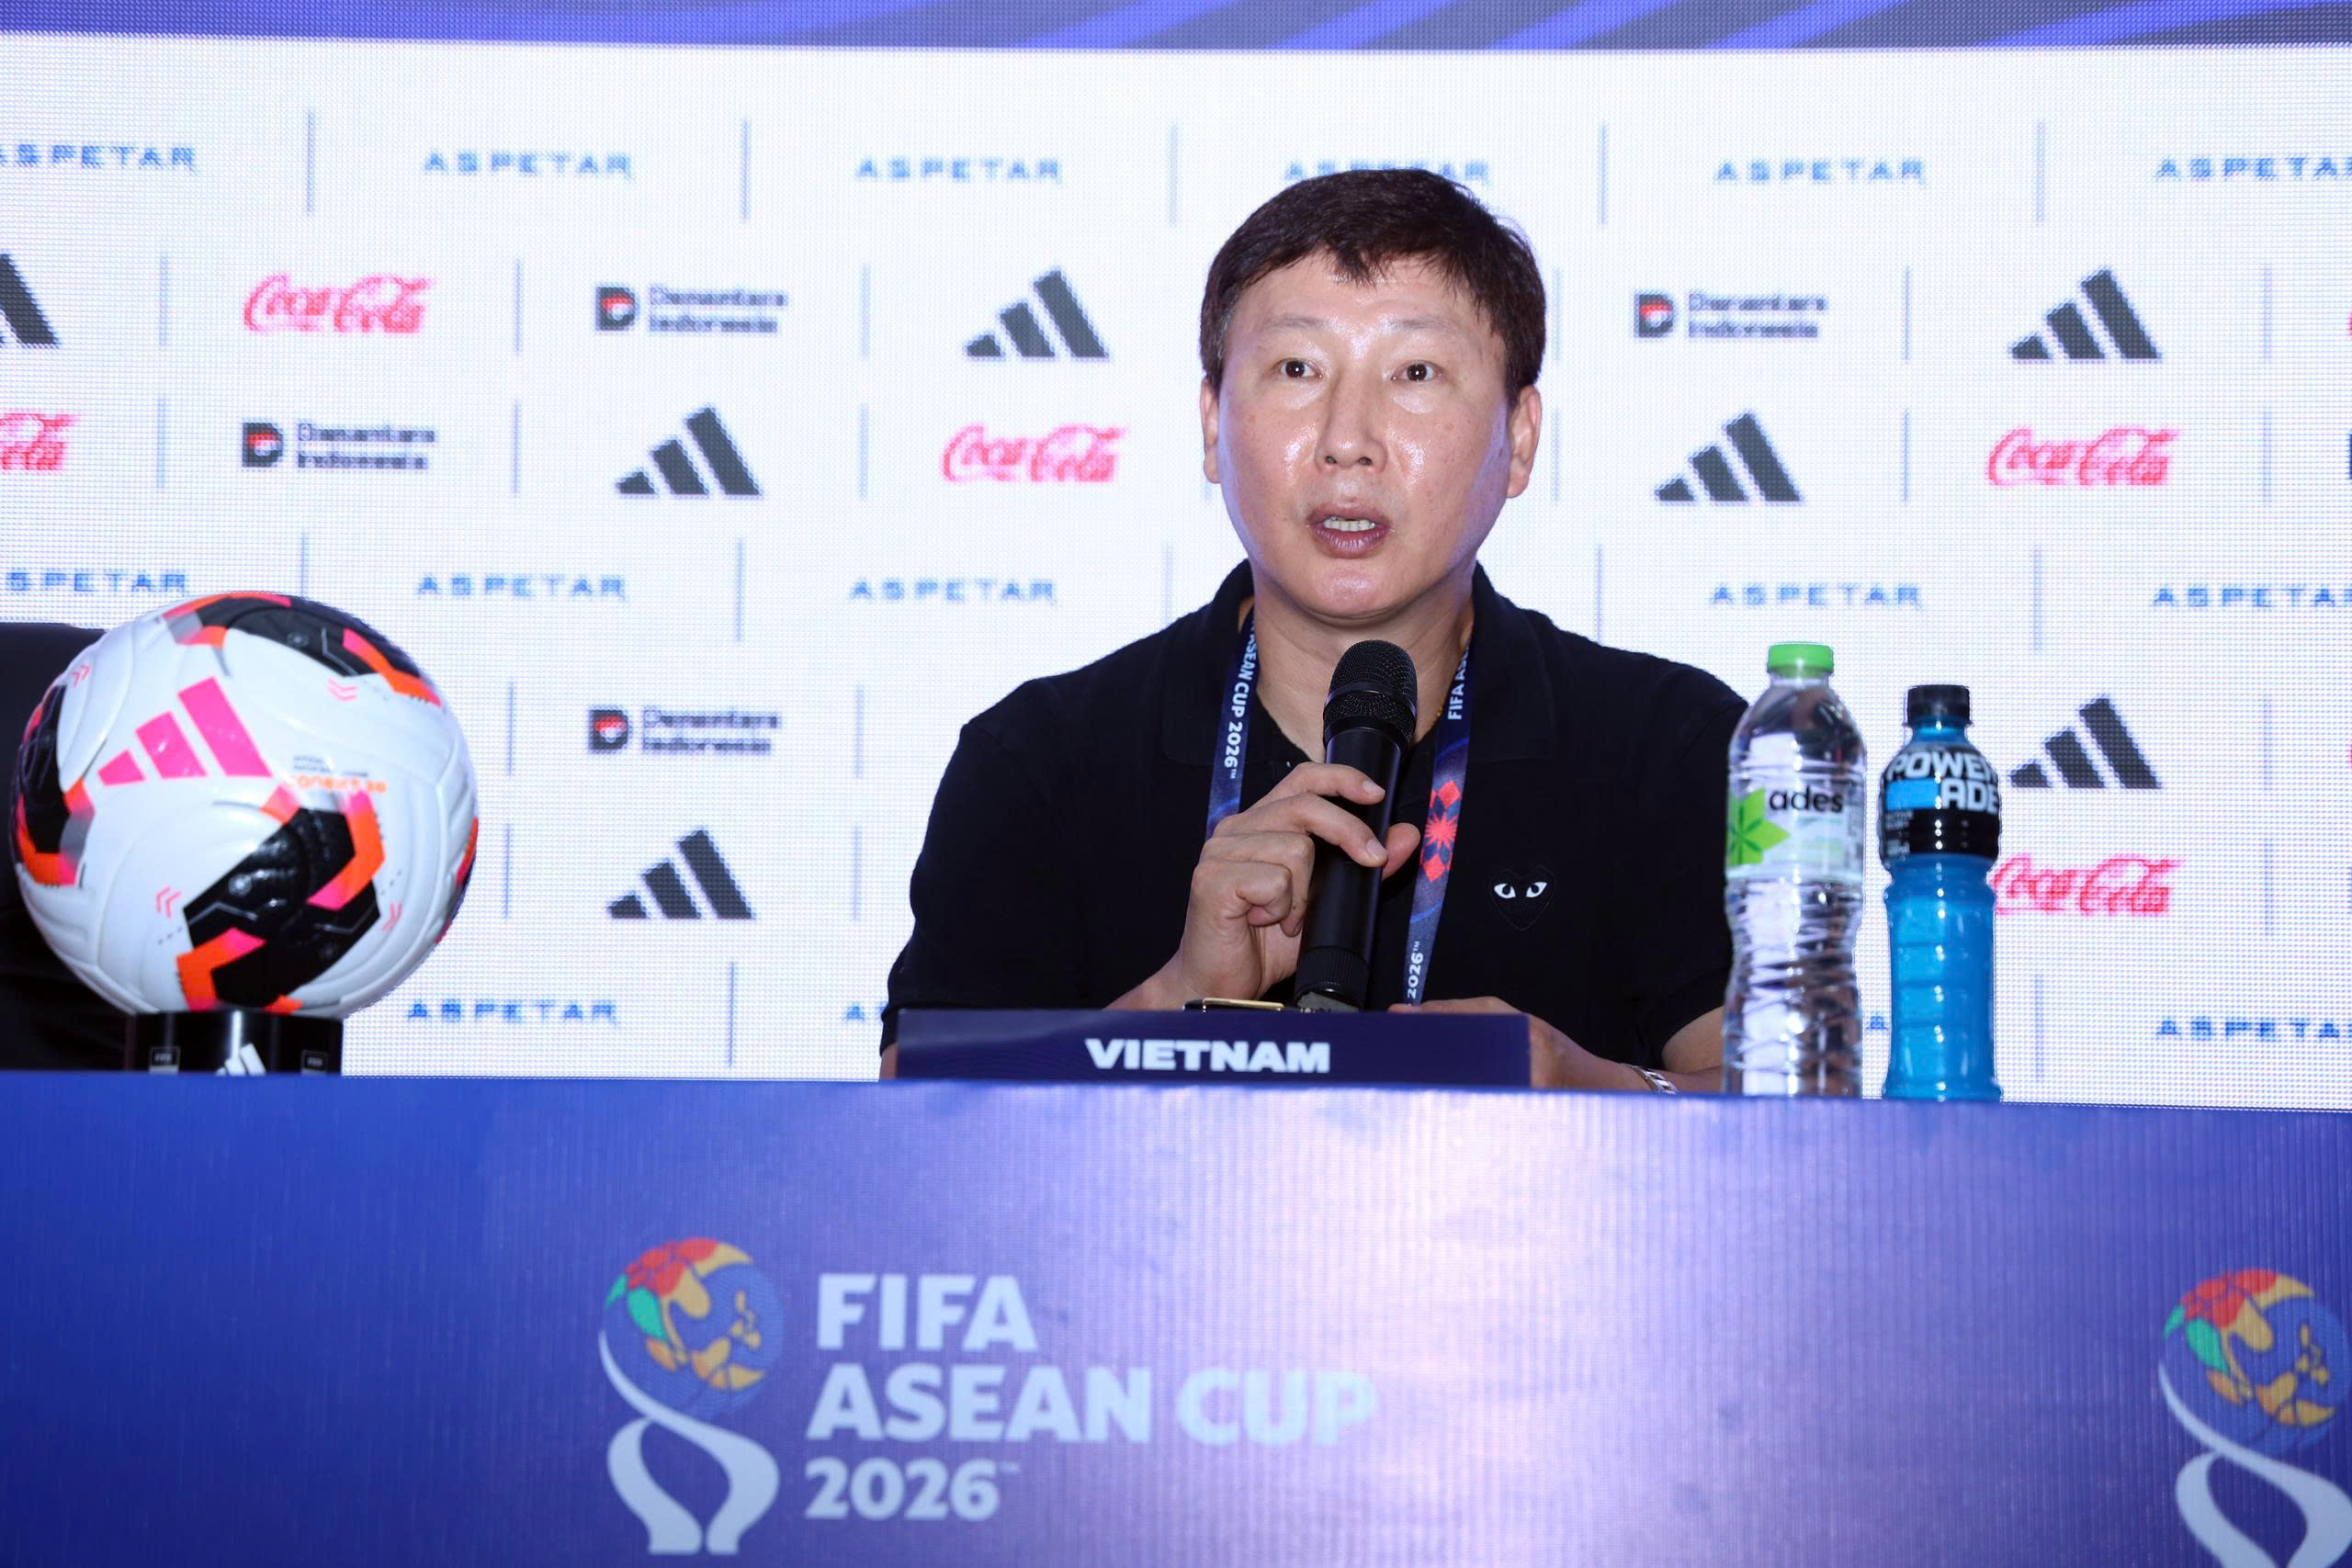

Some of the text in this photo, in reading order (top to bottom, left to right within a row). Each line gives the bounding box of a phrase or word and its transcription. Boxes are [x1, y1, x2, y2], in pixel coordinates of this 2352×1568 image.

[424, 152, 632, 178] ASPETAR
[856, 157, 1062, 182] ASPETAR
[1715, 159, 1925, 185] ASPETAR
[6, 570, 188, 597] SPETAR
[417, 573, 626, 600] ASPETAR
[850, 579, 1056, 604] ASPETAR
[1711, 583, 1921, 608] ASPETAR
[1231, 682, 1250, 718] CUP
[1447, 682, 1464, 720] FIFA
[1769, 785, 1843, 813] ades
[1939, 778, 1998, 815] ADE
[407, 998, 619, 1025] ASPETAR
[1084, 1038, 1330, 1073] VIETNAM
[816, 1273, 1038, 1351] FIFA
[806, 1363, 1378, 1446] ASEAN CUP
